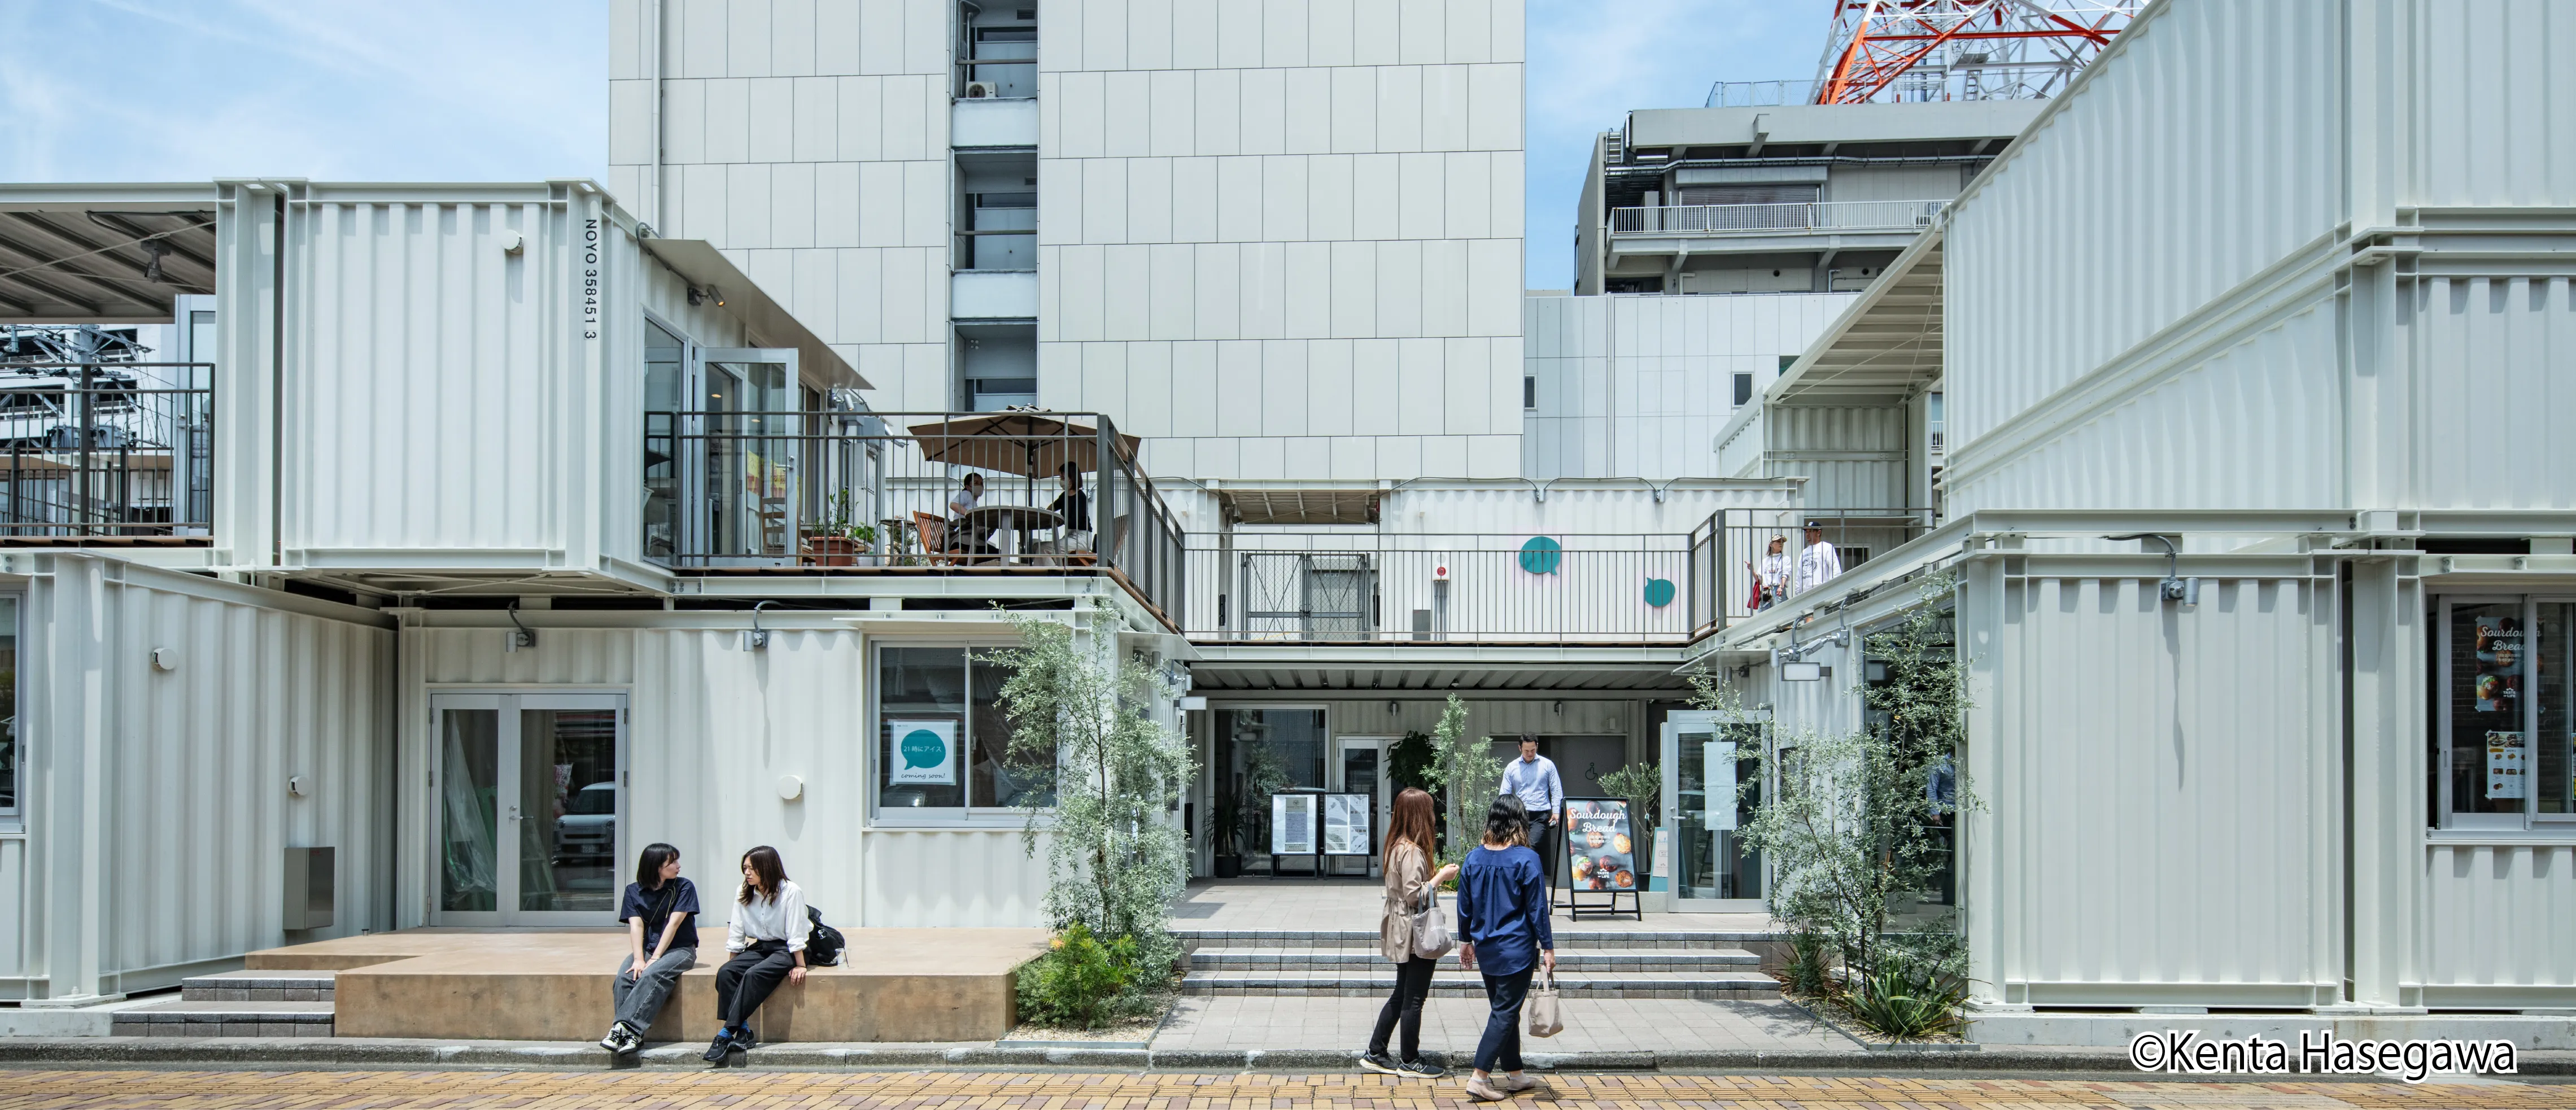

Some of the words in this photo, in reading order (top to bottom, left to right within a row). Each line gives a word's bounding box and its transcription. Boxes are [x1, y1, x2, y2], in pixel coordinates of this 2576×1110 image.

[586, 219, 597, 264] NOYO
[585, 269, 597, 322] 358451
[1570, 809, 1626, 823] Sourdough
[1582, 822, 1617, 832] Bread
